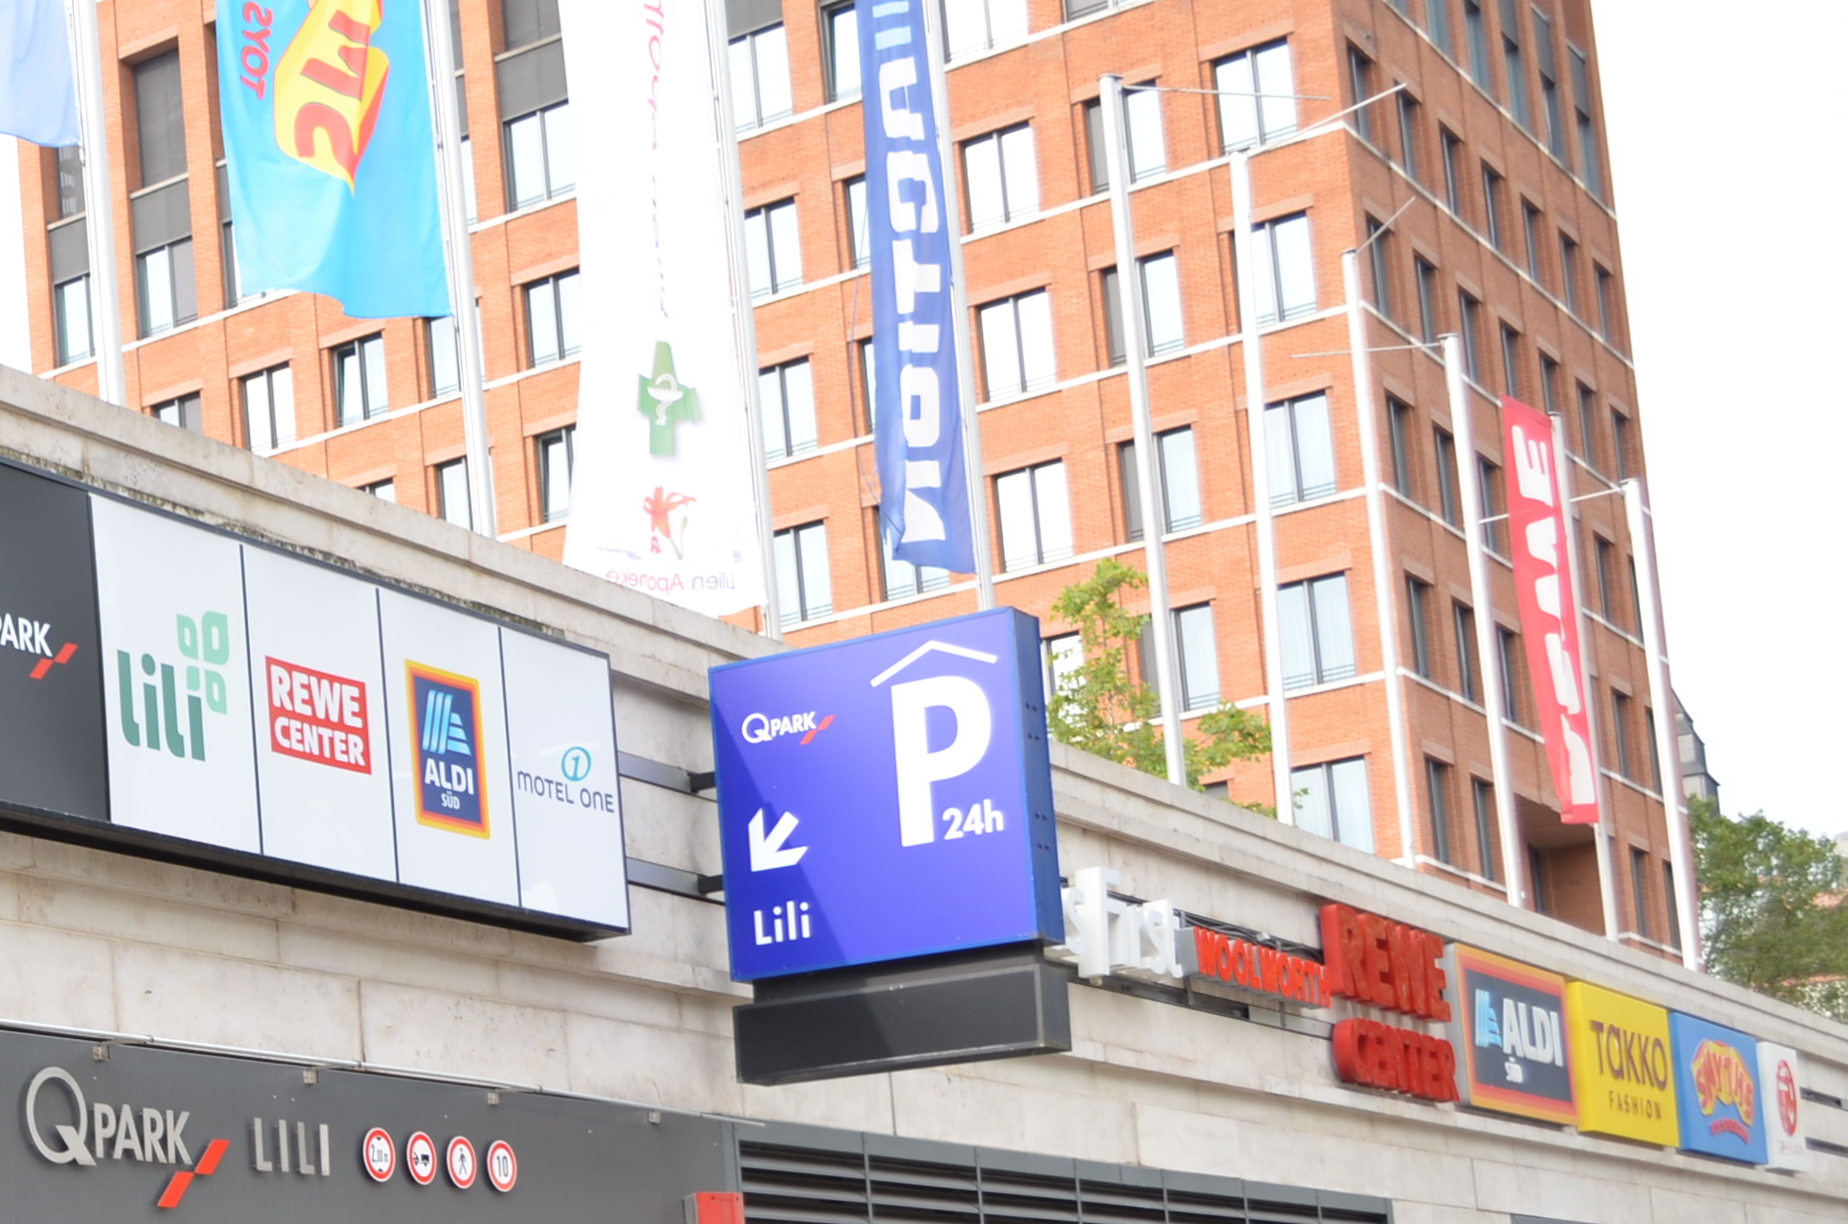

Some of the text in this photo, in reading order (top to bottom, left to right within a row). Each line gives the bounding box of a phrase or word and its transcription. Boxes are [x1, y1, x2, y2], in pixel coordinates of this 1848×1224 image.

[269, 663, 364, 729] REWE
[274, 716, 366, 767] CENTER
[890, 675, 992, 847] P
[424, 757, 475, 796] ALDI
[440, 791, 461, 810] SÜD
[517, 770, 615, 814] MOTEL ONE
[941, 798, 1005, 841] 24h
[753, 900, 812, 946] Lili
[1193, 925, 1332, 1009] WOOLWORTH
[1324, 904, 1452, 1023] REWE
[1502, 996, 1564, 1068] ALDI
[1334, 1017, 1461, 1103] CENTER
[1608, 1090, 1663, 1121] FASHION
[253, 1117, 331, 1177] LILI
[496, 1154, 509, 1178] 10
